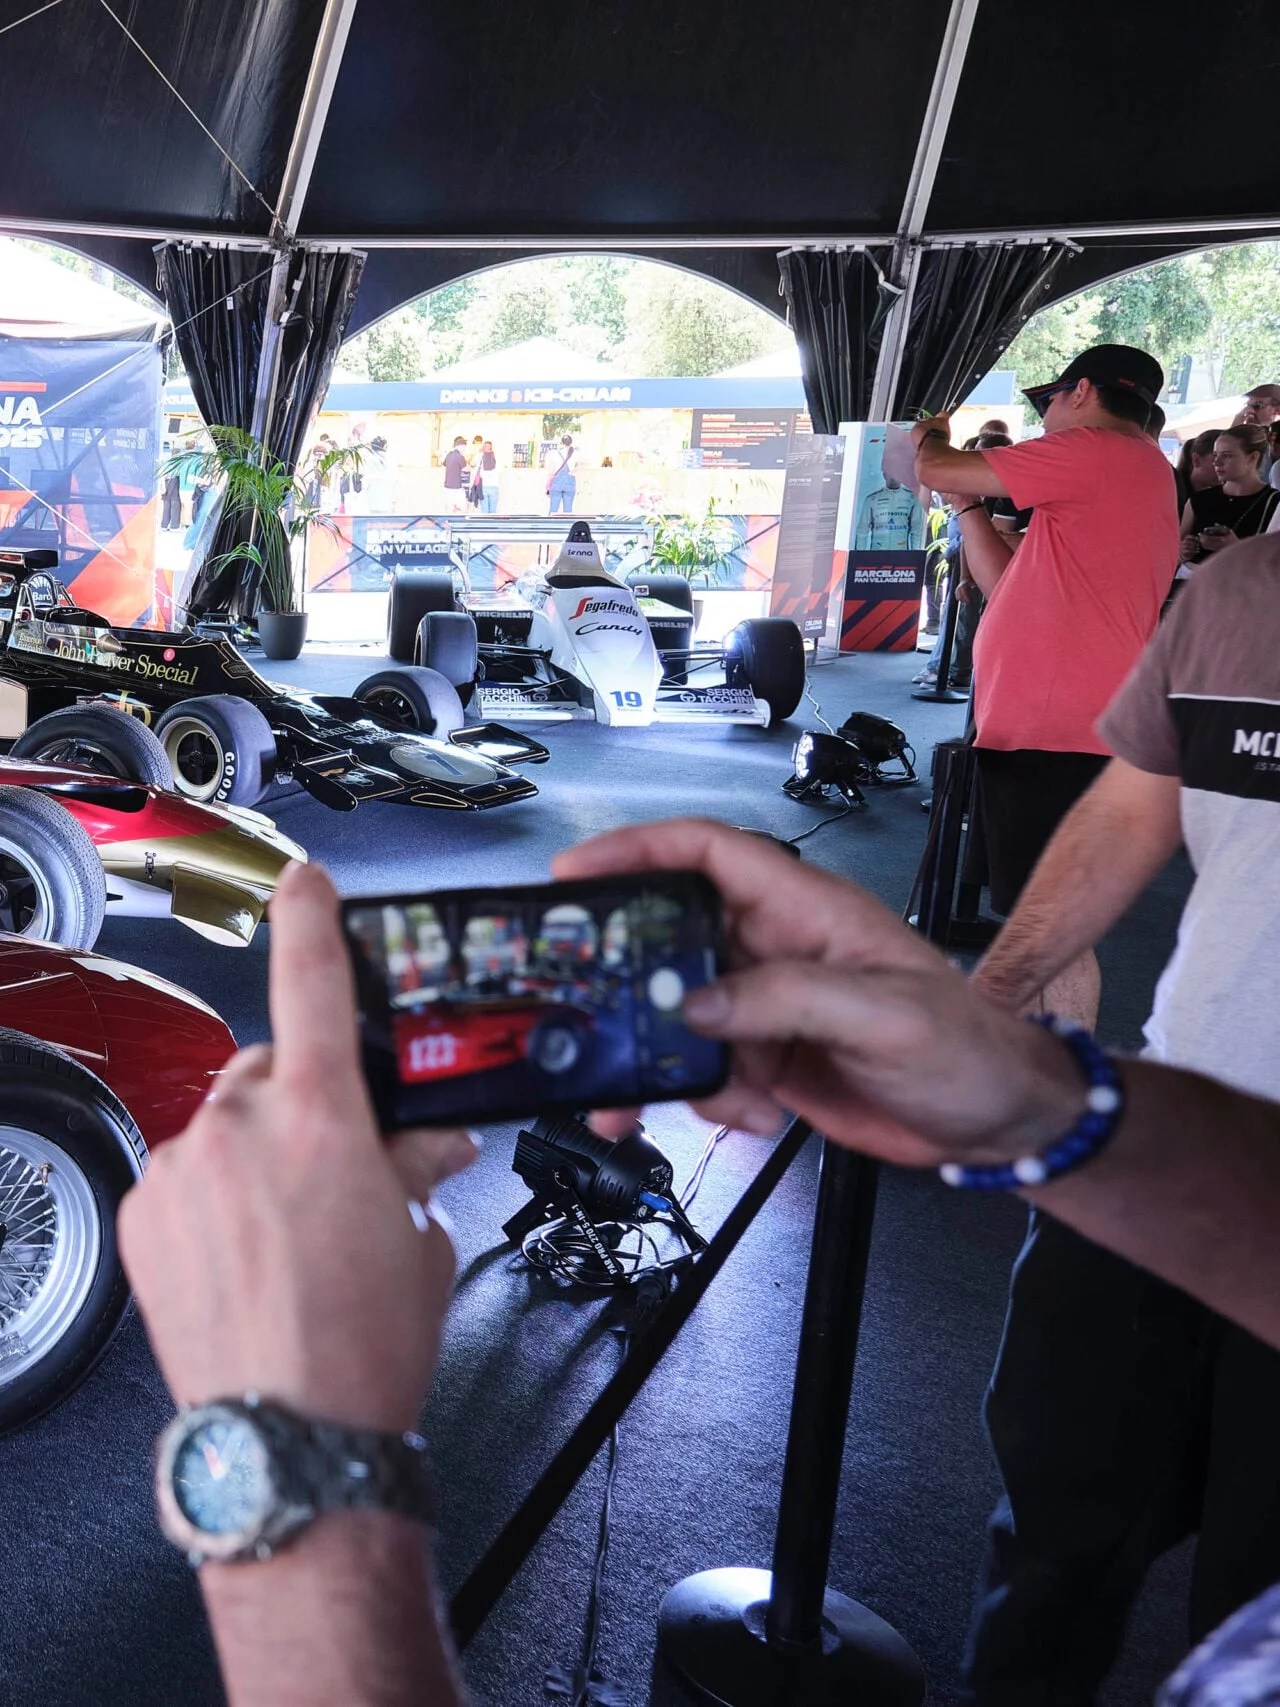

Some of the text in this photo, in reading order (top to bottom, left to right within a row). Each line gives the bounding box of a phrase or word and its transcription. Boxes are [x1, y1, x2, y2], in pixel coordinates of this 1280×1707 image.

[439, 389, 509, 404] DRINKS
[523, 387, 632, 402] ICE-CREAM
[567, 549, 594, 557] Senna
[568, 597, 639, 620] Segafredo
[475, 611, 531, 619] MICHELIN
[575, 621, 644, 636] Candy
[649, 621, 690, 629] CHELIN
[53, 638, 86, 662] John
[135, 653, 199, 686] Special
[477, 688, 520, 696] SERGIO
[706, 688, 752, 697] SERGIO
[478, 695, 532, 703] TACCHINI
[610, 690, 643, 708] 19
[697, 696, 754, 704] TACCHINI
[216, 751, 235, 800] GOOD
[571, 1203, 618, 1275] PAR PRO 270 5-IN-1
